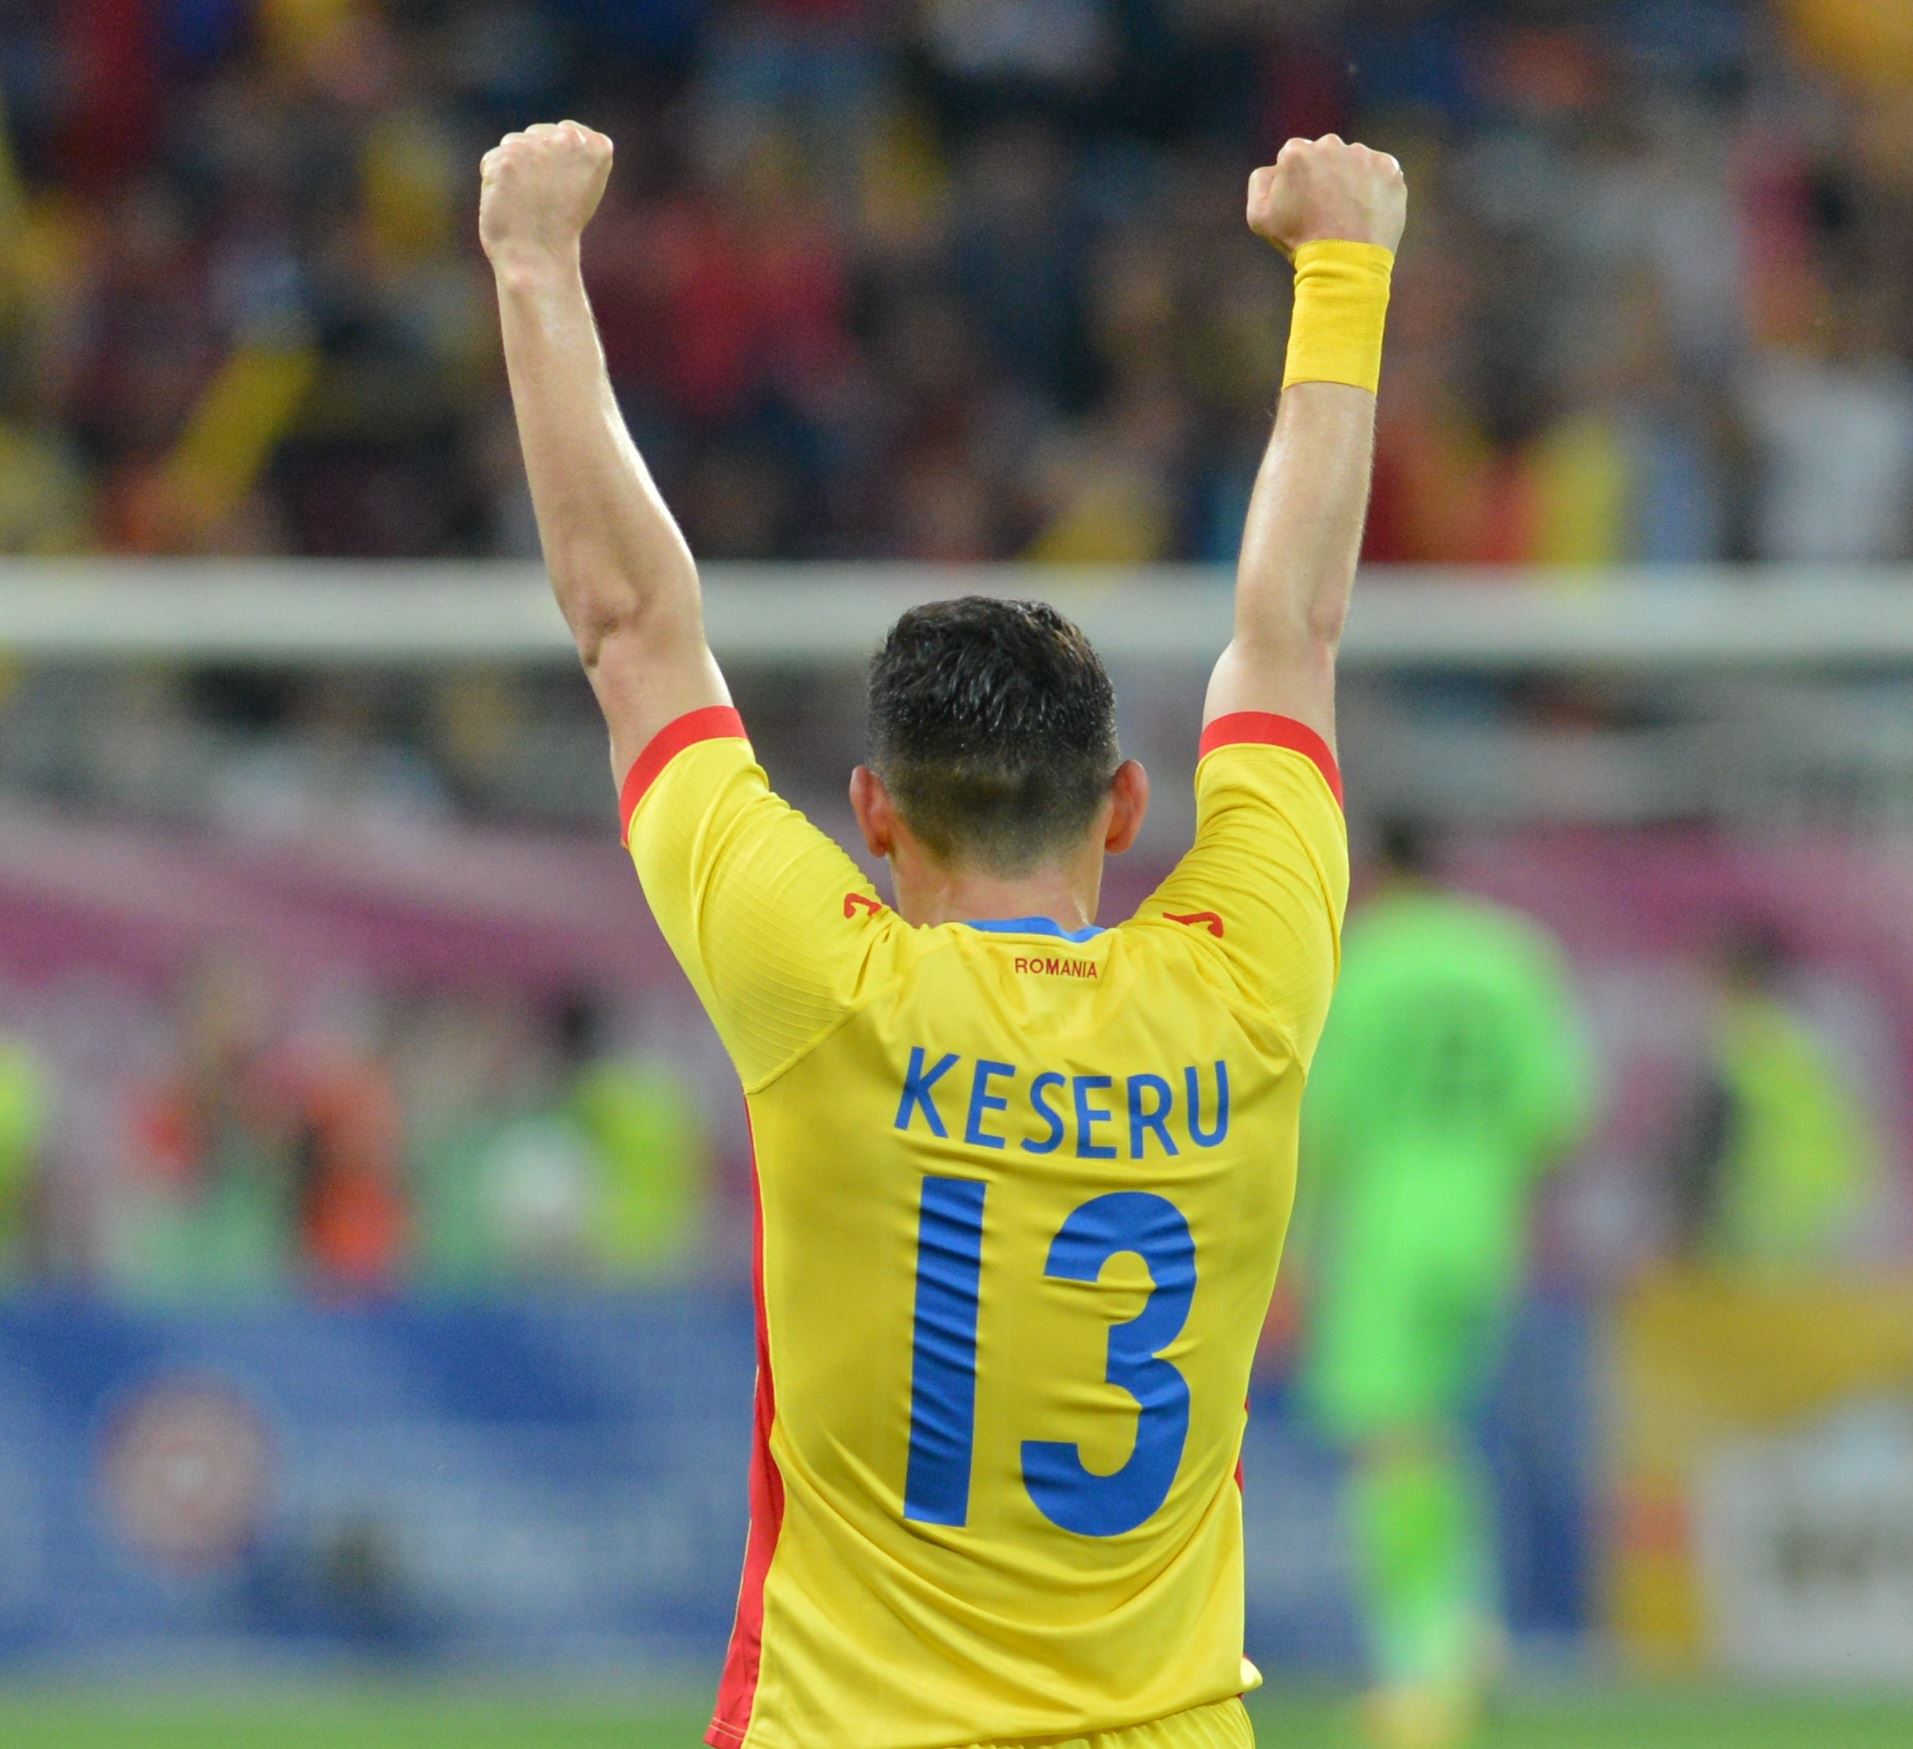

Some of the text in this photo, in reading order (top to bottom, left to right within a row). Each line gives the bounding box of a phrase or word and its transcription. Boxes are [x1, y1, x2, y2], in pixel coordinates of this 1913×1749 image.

[1014, 957, 1098, 979] ROMANIA
[895, 1046, 1229, 1159] KESERU
[904, 1176, 1197, 1537] 13
